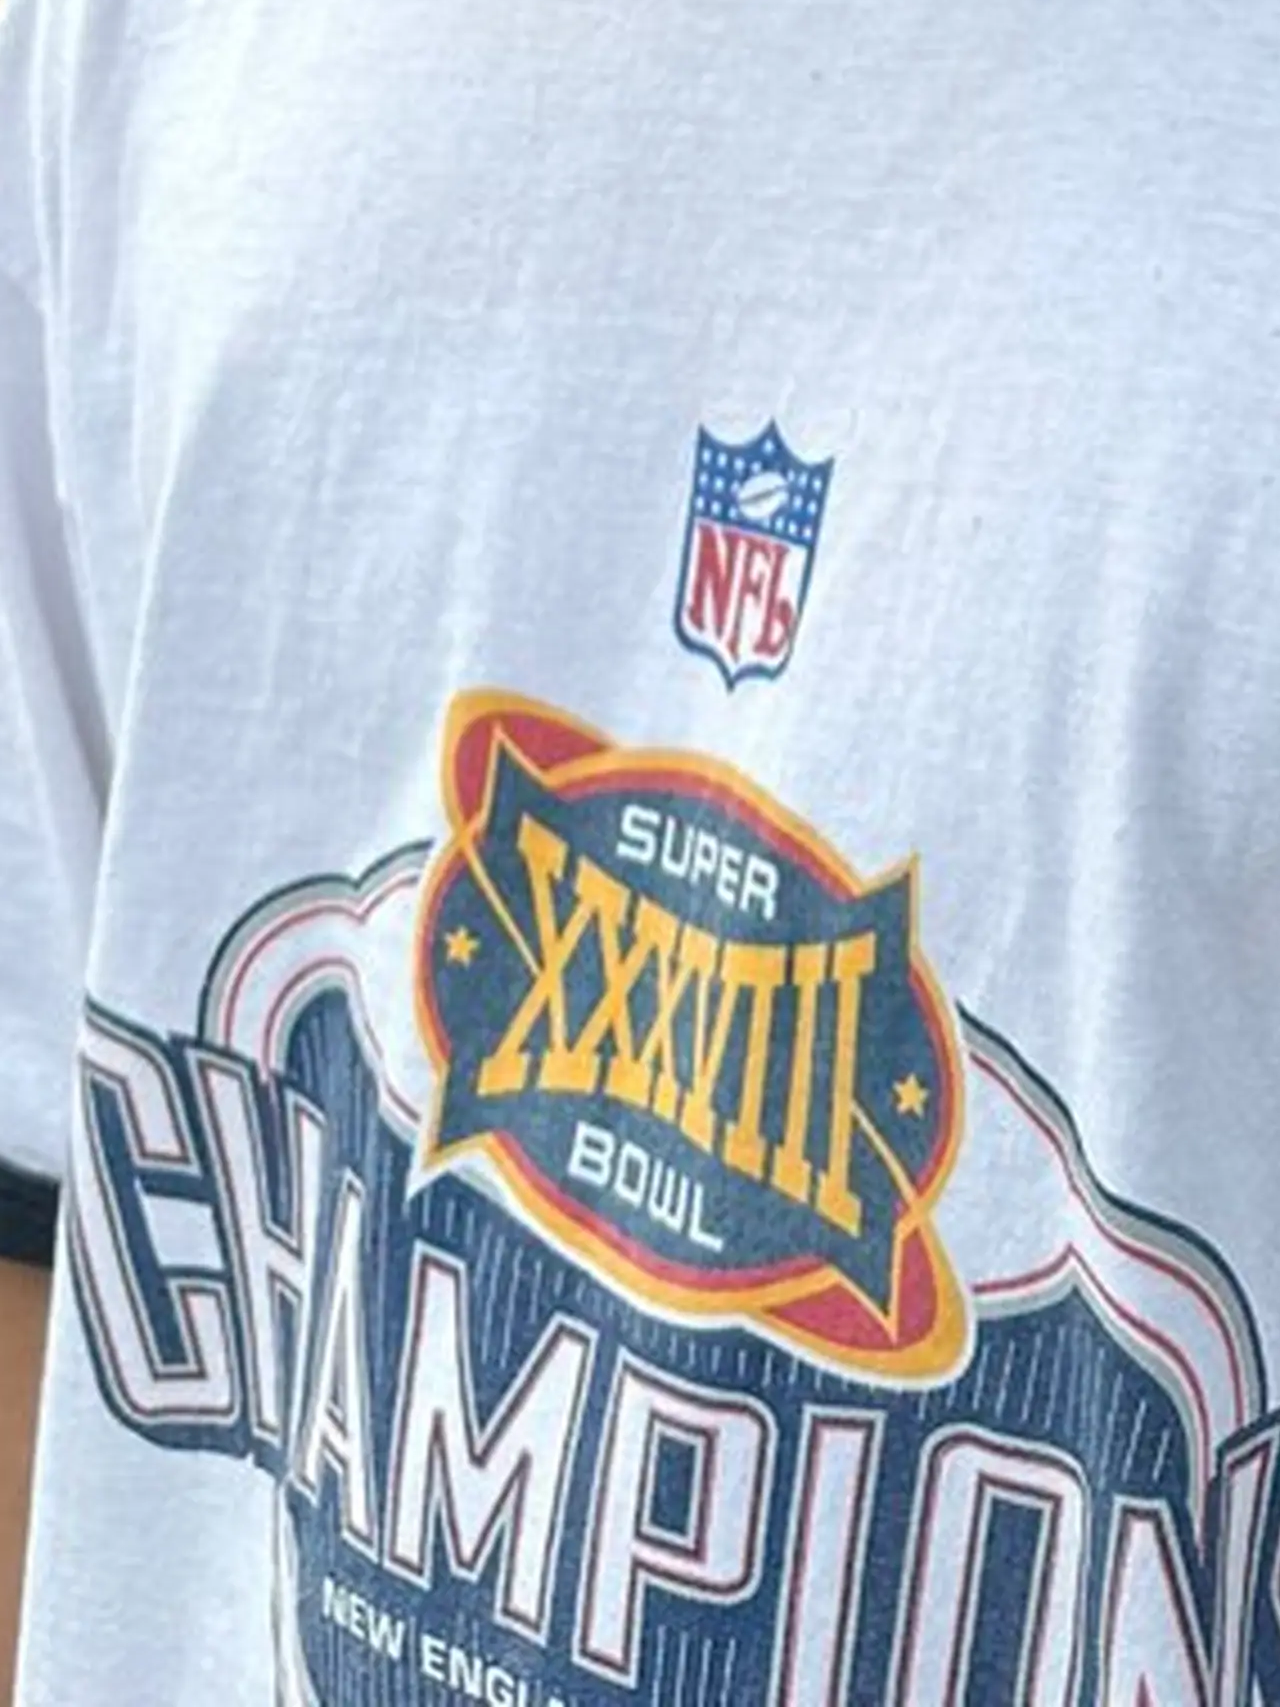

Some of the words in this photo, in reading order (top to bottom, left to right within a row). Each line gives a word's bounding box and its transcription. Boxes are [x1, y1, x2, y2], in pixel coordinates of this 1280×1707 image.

[687, 521, 795, 665] NFL
[616, 804, 781, 921] SUPER
[477, 812, 877, 1239] XXXVIII
[567, 1120, 725, 1252] BOWL
[321, 1575, 405, 1662] NEW
